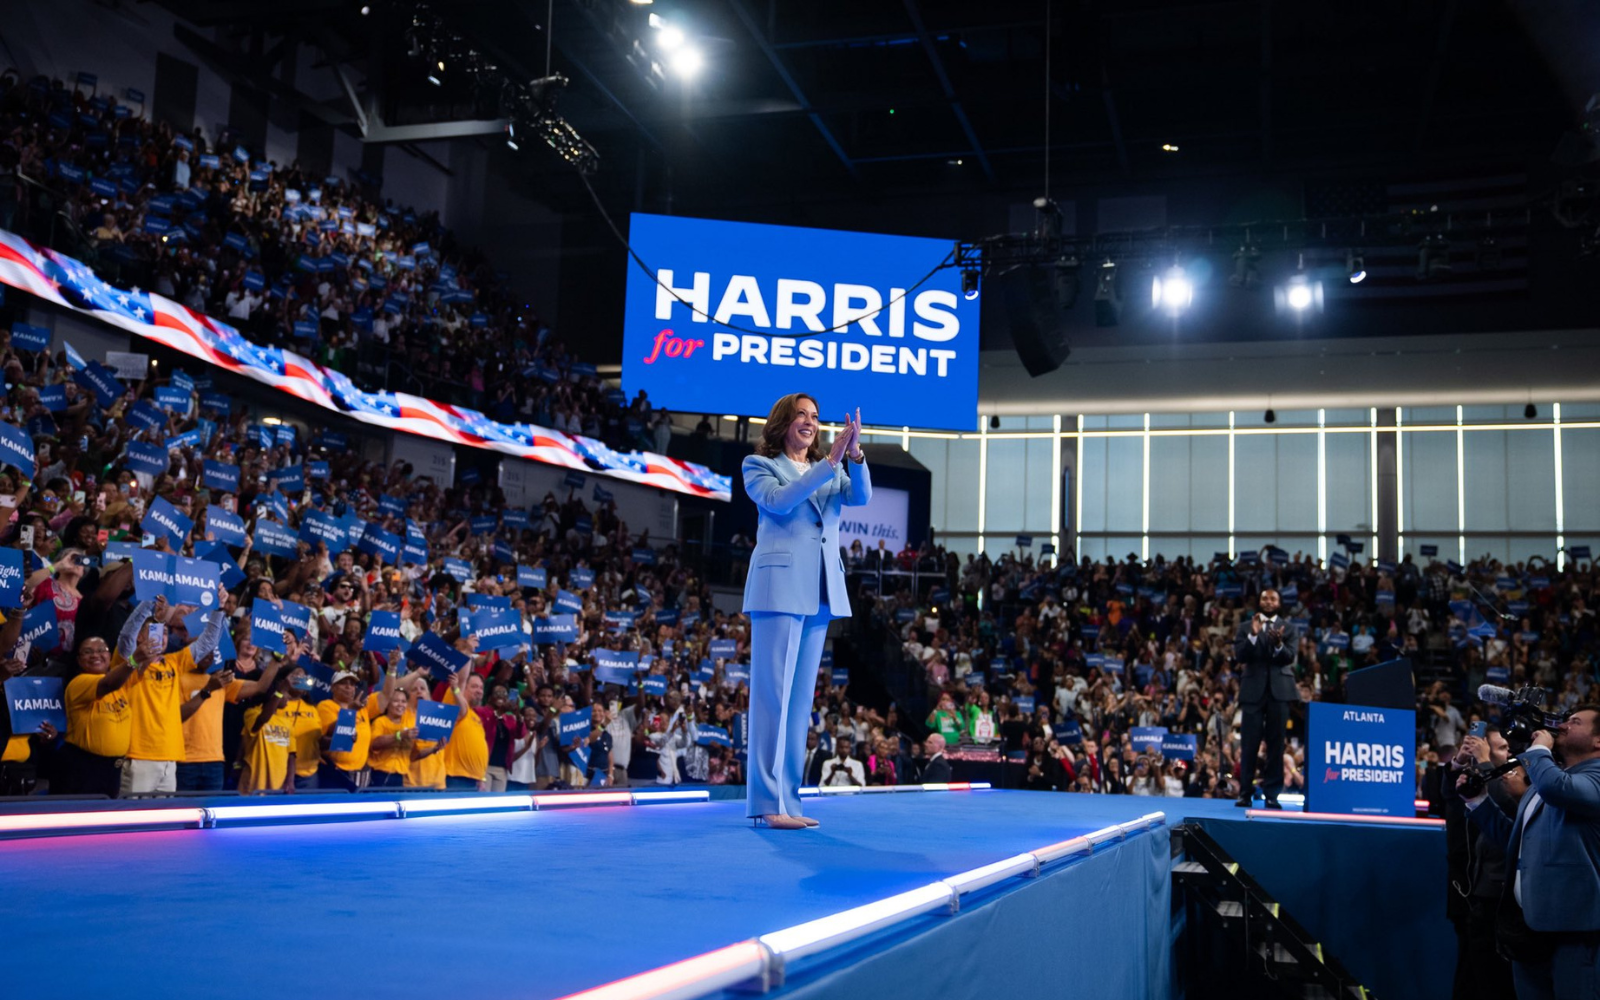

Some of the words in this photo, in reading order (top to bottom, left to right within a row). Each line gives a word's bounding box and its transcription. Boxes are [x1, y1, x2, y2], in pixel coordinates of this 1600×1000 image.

[655, 268, 960, 342] HARRIS
[643, 329, 704, 364] for
[712, 332, 956, 377] PRESIDENT
[84, 369, 114, 398] KAMALA
[0, 436, 35, 461] KAMALA
[129, 451, 163, 466] KAMALA
[206, 469, 236, 482] KAMALA
[151, 510, 184, 539] KAMALA
[209, 518, 246, 534] KAMALA
[839, 520, 868, 535] WIN
[872, 522, 899, 539] this.
[363, 532, 397, 554] KAMALA
[175, 573, 216, 590] AMALA
[475, 623, 517, 638] KAMALA
[536, 625, 572, 633] KAMALA
[418, 643, 457, 672] KAMALA
[599, 659, 634, 669] KAMALA
[14, 699, 62, 711] KAMALA
[420, 715, 452, 729] KAMALA
[1343, 711, 1385, 723] ATLANTA
[562, 719, 590, 733] KAMALA
[1162, 743, 1193, 751] KAMALA
[1325, 741, 1405, 768] HARRIS
[1323, 767, 1340, 784] for
[1341, 768, 1404, 784] PRESIDENT
